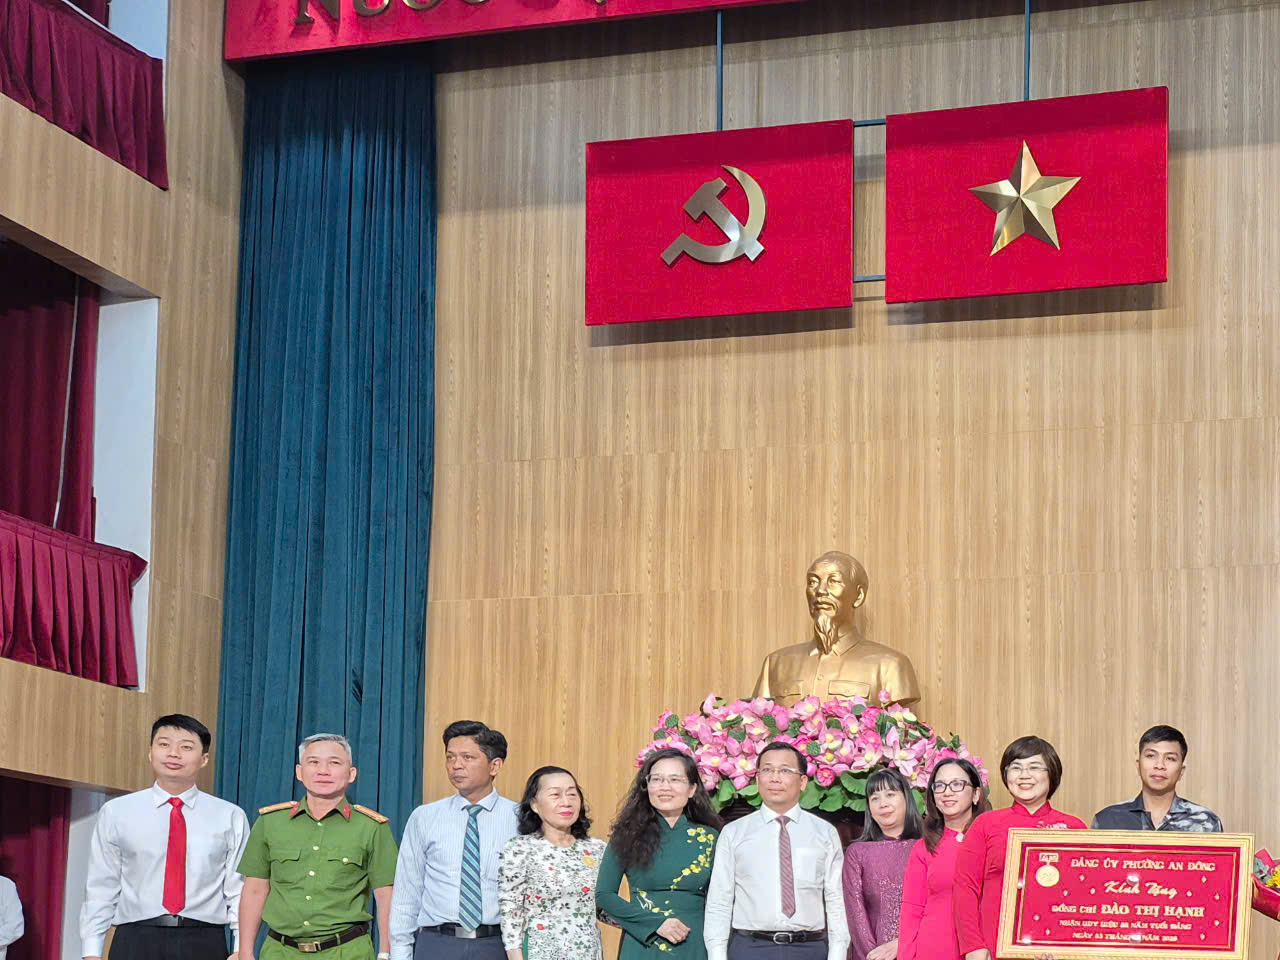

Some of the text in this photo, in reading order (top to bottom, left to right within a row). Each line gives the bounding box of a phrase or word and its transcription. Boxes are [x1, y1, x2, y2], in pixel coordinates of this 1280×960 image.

[1168, 861, 1184, 870] AN
[1187, 860, 1216, 871] ĐÔNG
[1101, 901, 1130, 914] ĐÀO
[1134, 905, 1160, 917] THỊ
[1163, 905, 1205, 918] HẠNH
